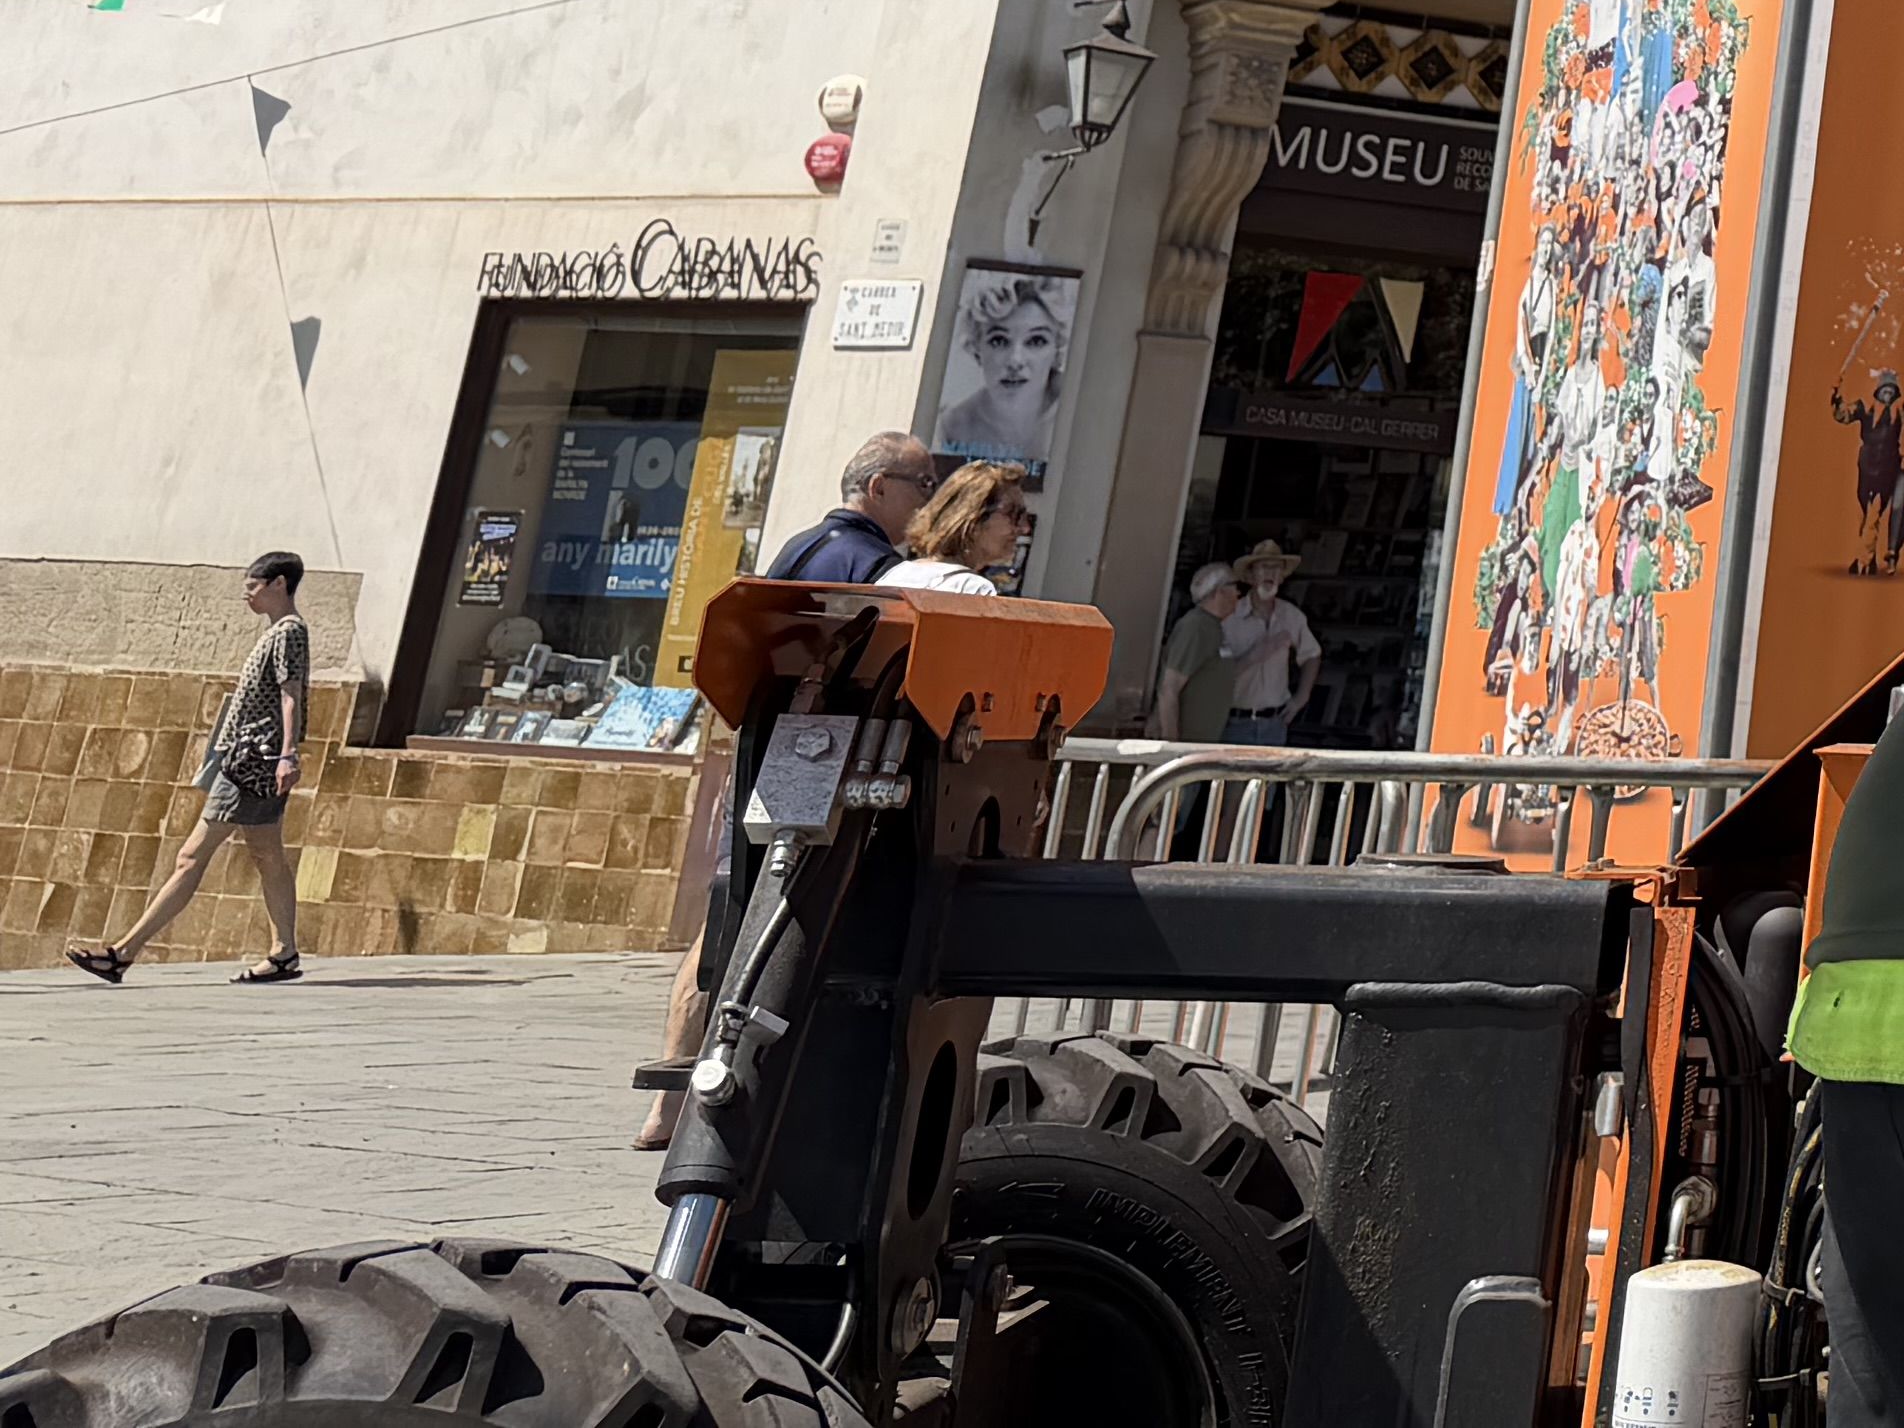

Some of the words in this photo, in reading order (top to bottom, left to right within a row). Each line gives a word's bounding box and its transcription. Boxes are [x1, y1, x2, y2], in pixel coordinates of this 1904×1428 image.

[1269, 122, 1449, 187] MUSEU
[1245, 405, 1288, 426] CASA
[541, 540, 590, 571] any
